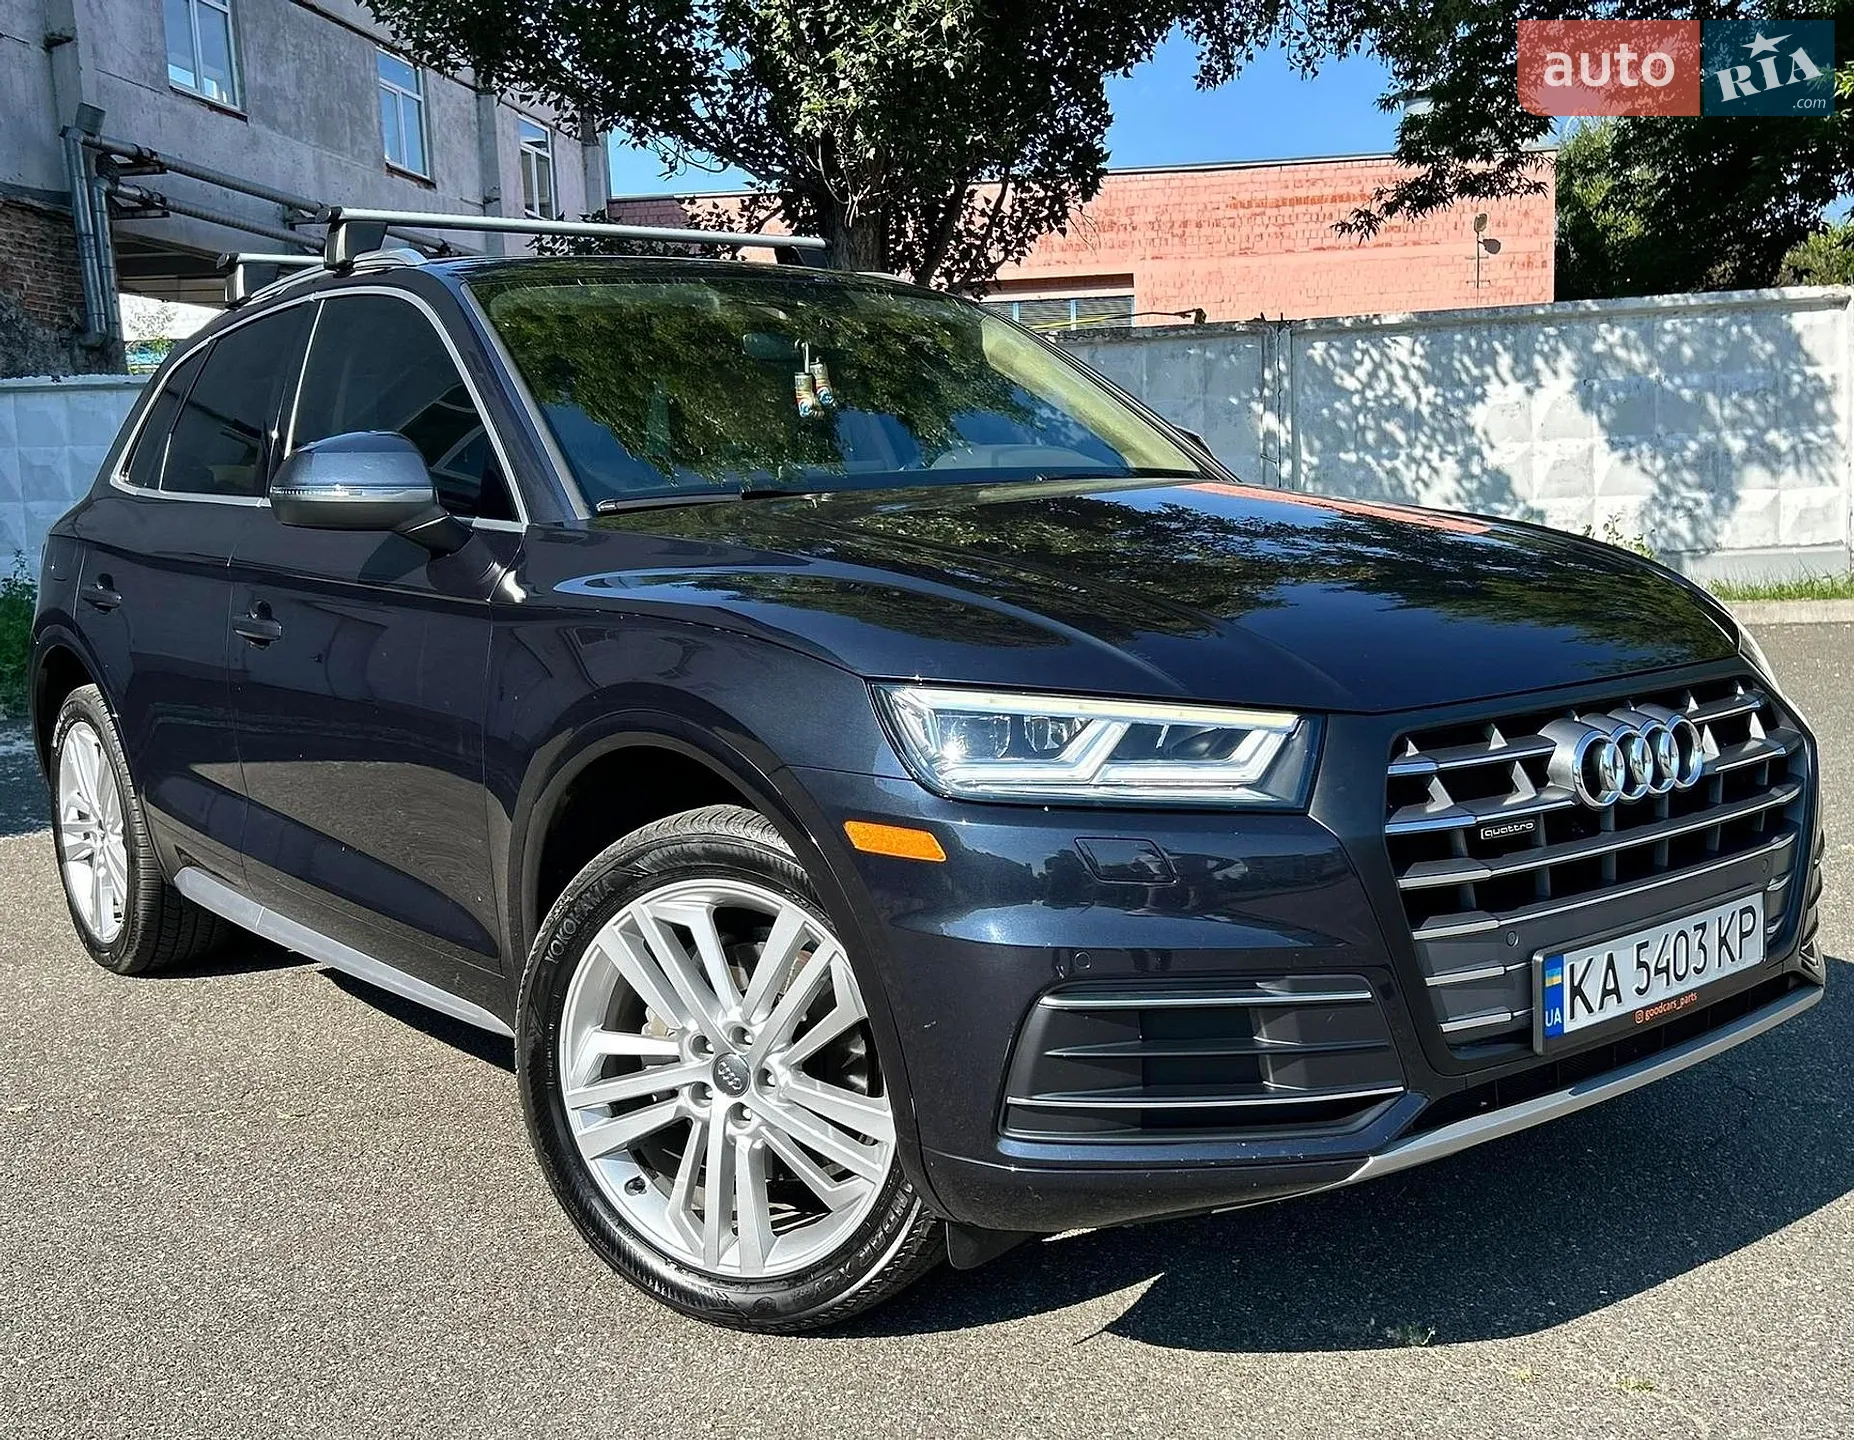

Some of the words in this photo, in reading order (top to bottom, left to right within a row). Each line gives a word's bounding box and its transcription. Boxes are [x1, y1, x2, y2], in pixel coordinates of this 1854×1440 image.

[1484, 822, 1534, 838] quattro
[544, 879, 615, 964] YOKOHAMA
[1569, 952, 1622, 1020] KA
[1634, 922, 1708, 995] 5403
[1717, 905, 1756, 968] KP
[1545, 1008, 1562, 1027] UA
